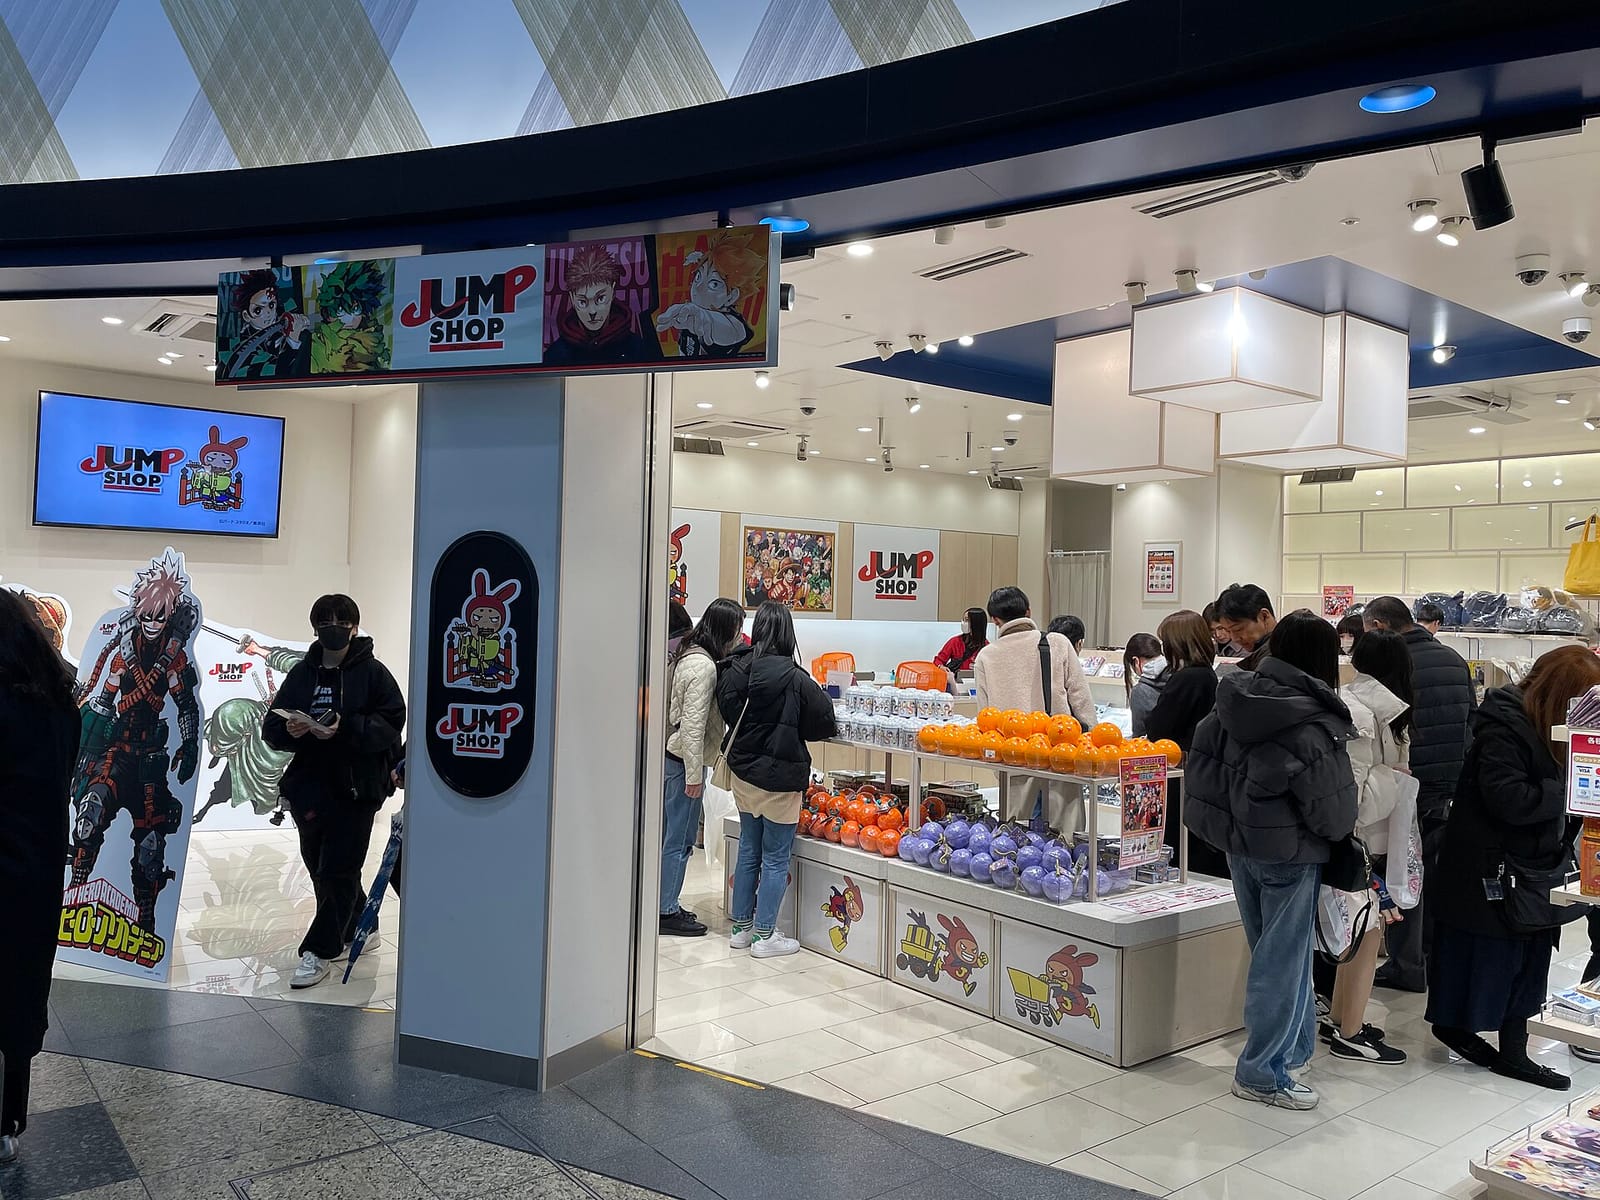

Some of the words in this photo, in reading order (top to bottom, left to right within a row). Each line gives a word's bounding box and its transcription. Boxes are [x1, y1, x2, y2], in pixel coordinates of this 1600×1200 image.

[400, 265, 537, 327] JUMP
[429, 317, 504, 343] SHOP
[80, 445, 184, 473] JUMP
[104, 471, 161, 487] SHOP
[858, 550, 934, 582] JUMP
[876, 579, 917, 594] SHOP
[209, 662, 253, 675] JUMP
[439, 707, 520, 735] JUMP
[456, 733, 501, 749] SHOP
[62, 887, 78, 906] MY
[77, 880, 102, 904] HERO
[100, 880, 140, 921] ACADEMIA
